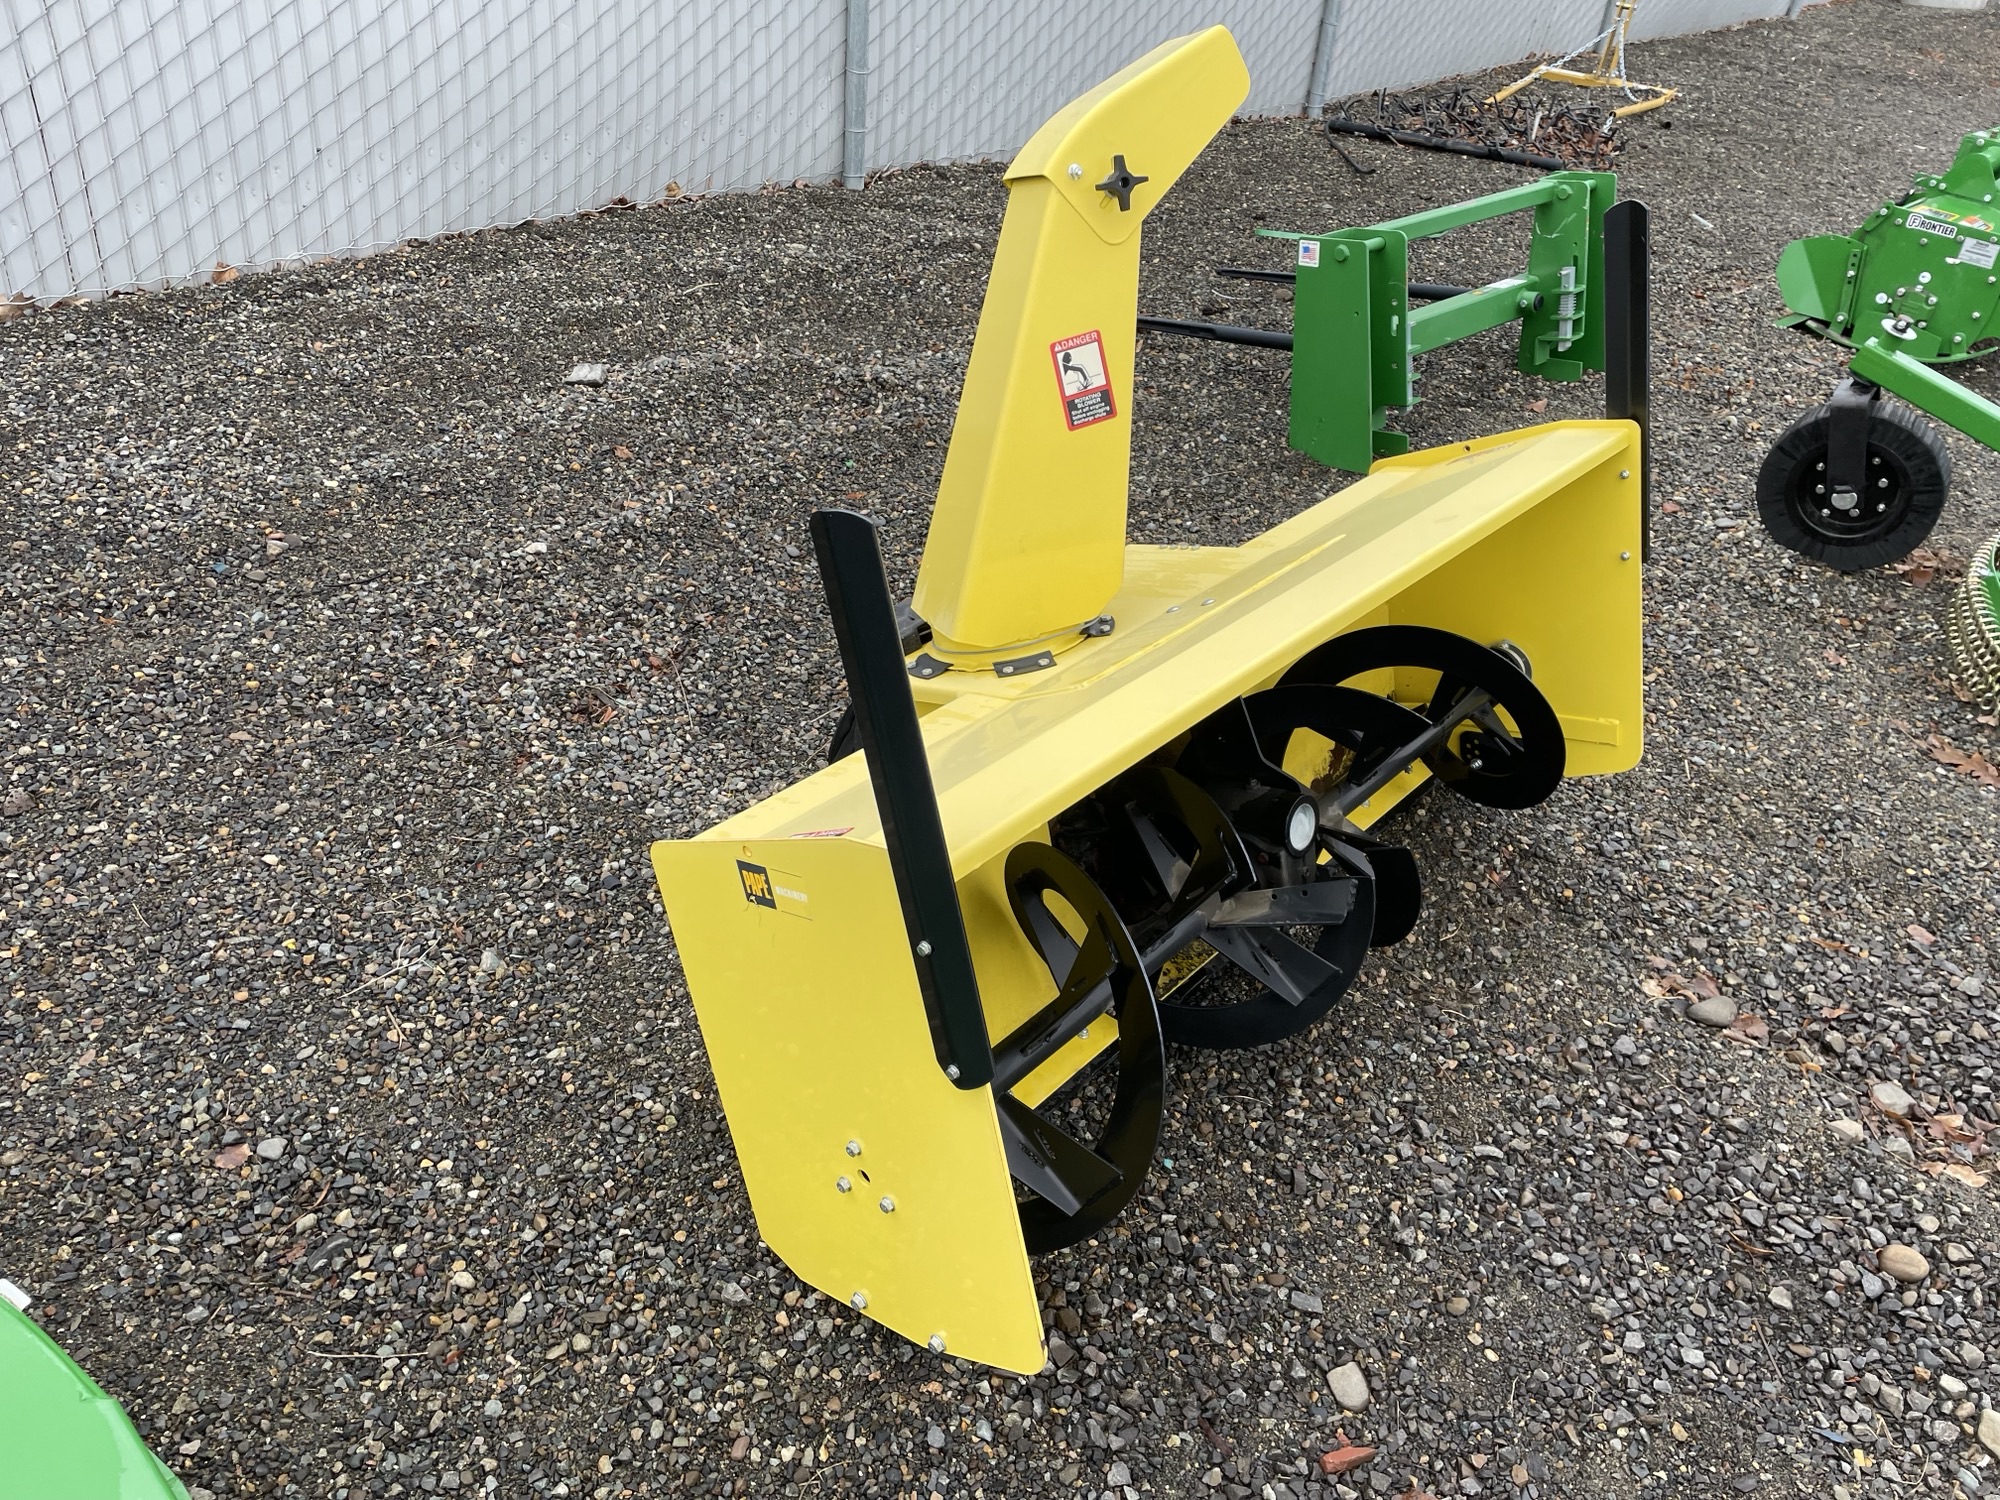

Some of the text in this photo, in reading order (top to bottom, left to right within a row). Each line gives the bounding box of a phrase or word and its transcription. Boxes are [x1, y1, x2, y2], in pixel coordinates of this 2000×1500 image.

[1908, 214, 1955, 236] FRONTIER
[1061, 332, 1098, 349] DANGER
[1075, 392, 1101, 404] ROTATING
[1077, 398, 1101, 409] BLOWER
